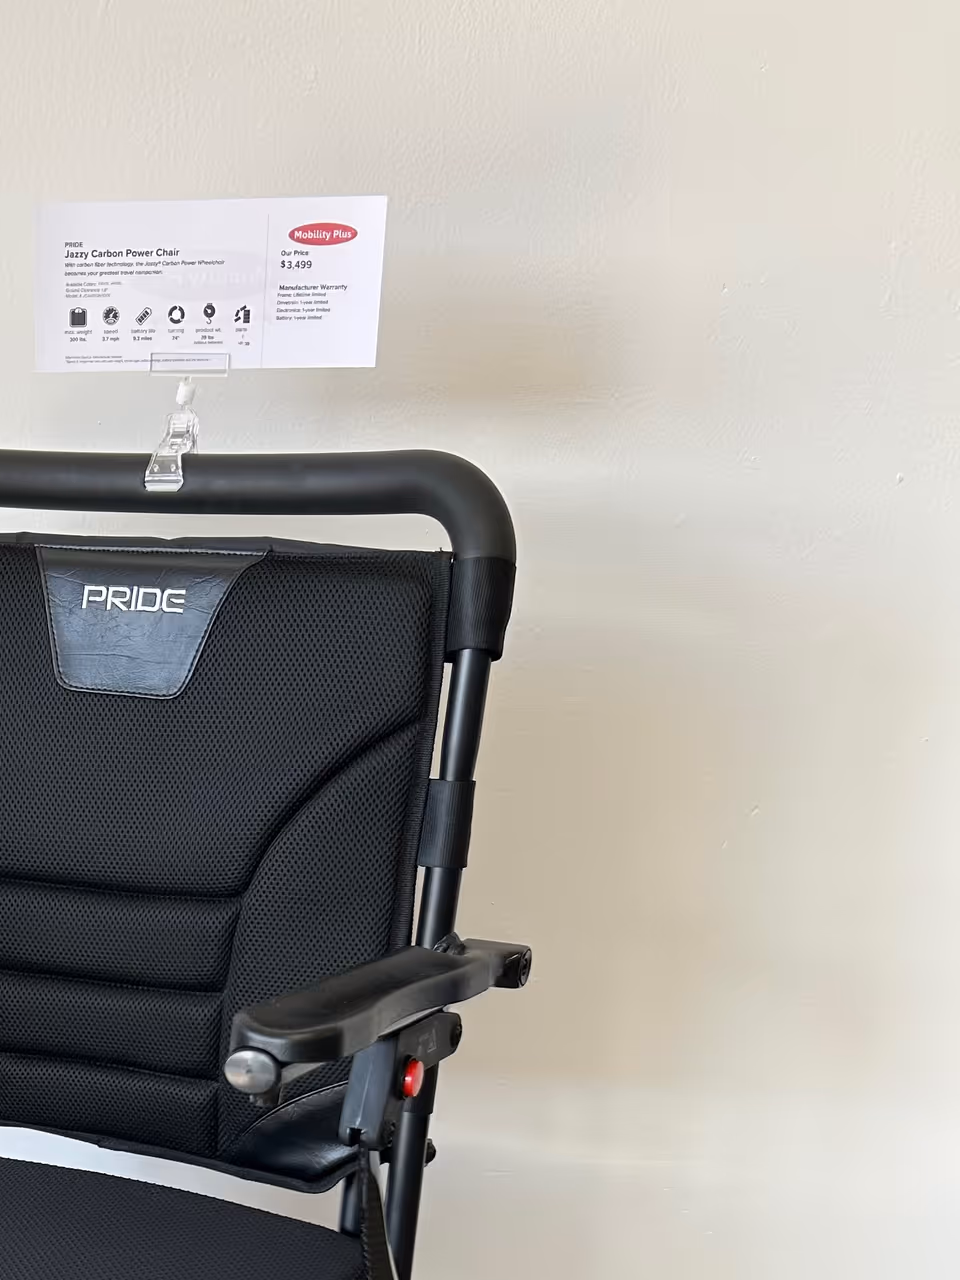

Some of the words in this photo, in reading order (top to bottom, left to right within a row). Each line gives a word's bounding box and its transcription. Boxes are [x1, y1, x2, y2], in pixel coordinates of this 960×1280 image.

[294, 230, 331, 240] Mobility
[333, 229, 352, 238] Plus
[64, 250, 89, 260] Jazzy
[91, 249, 124, 258] Carbon
[125, 249, 154, 257] Power
[156, 248, 180, 257] Chair
[280, 260, 312, 270] $3,499
[82, 585, 186, 613] PRIDE
